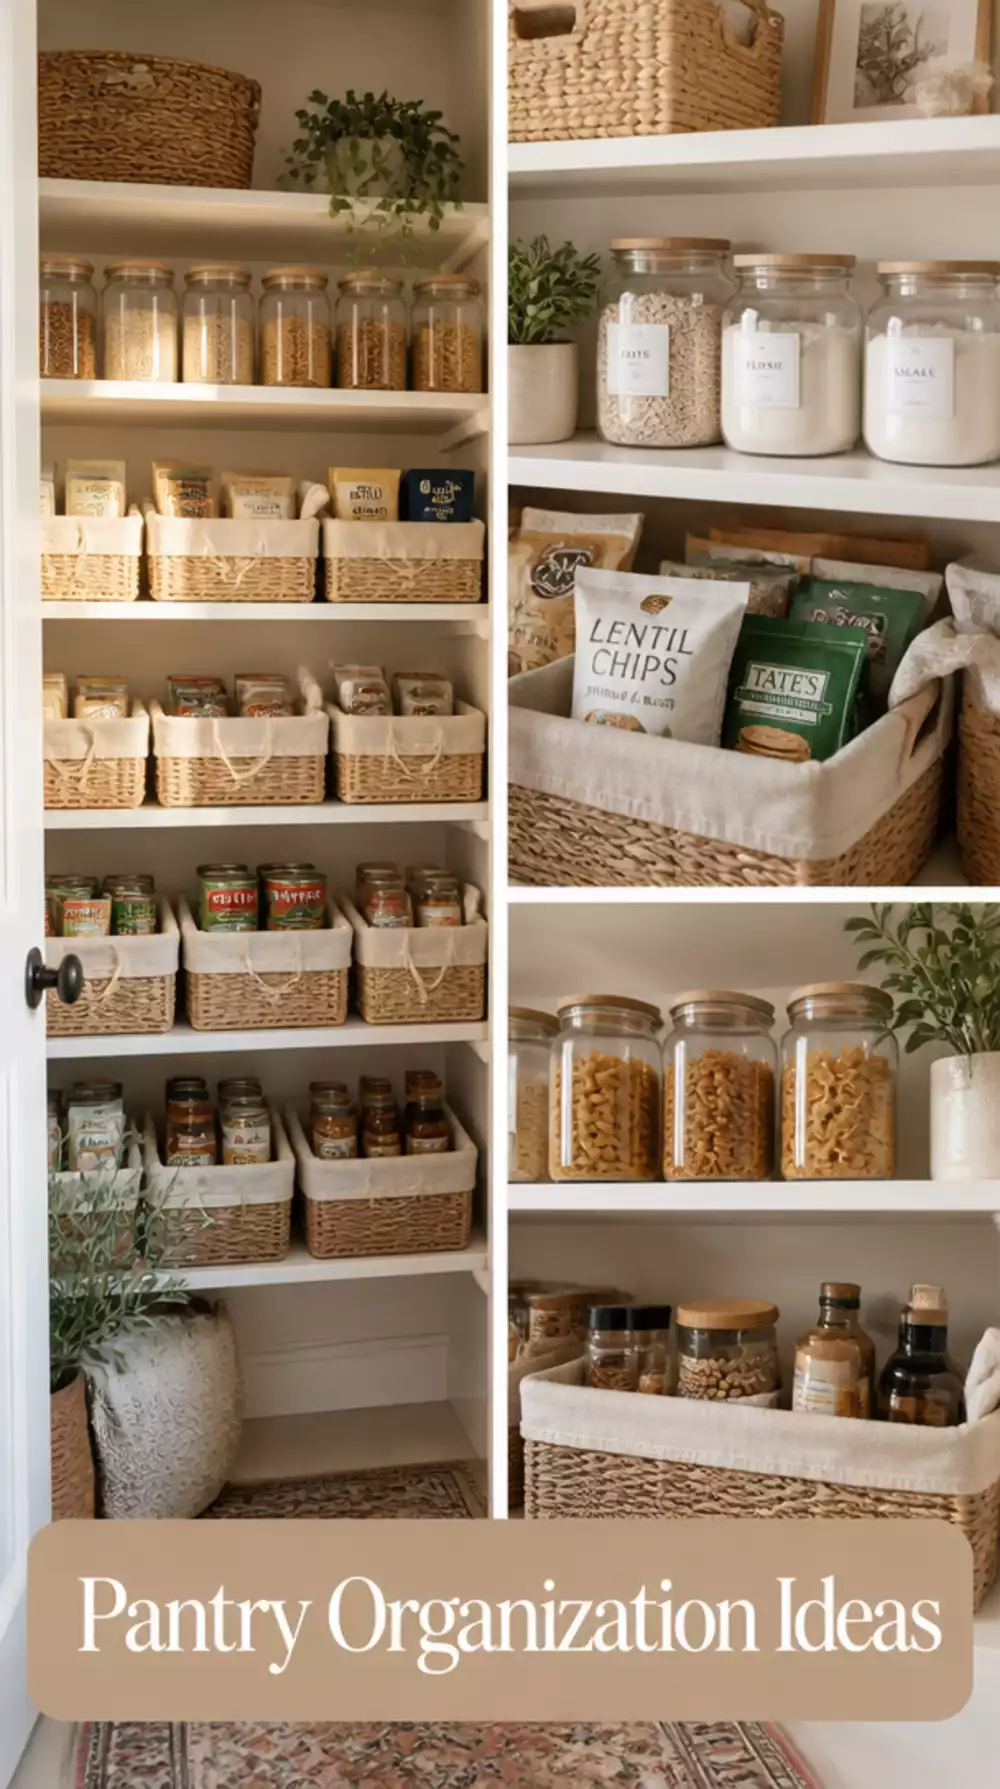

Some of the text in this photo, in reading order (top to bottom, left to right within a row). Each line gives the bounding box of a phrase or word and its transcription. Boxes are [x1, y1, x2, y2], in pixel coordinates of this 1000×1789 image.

[589, 618, 694, 656] LENTIL
[591, 648, 679, 686] CHIPS
[752, 667, 819, 696] TATE'S
